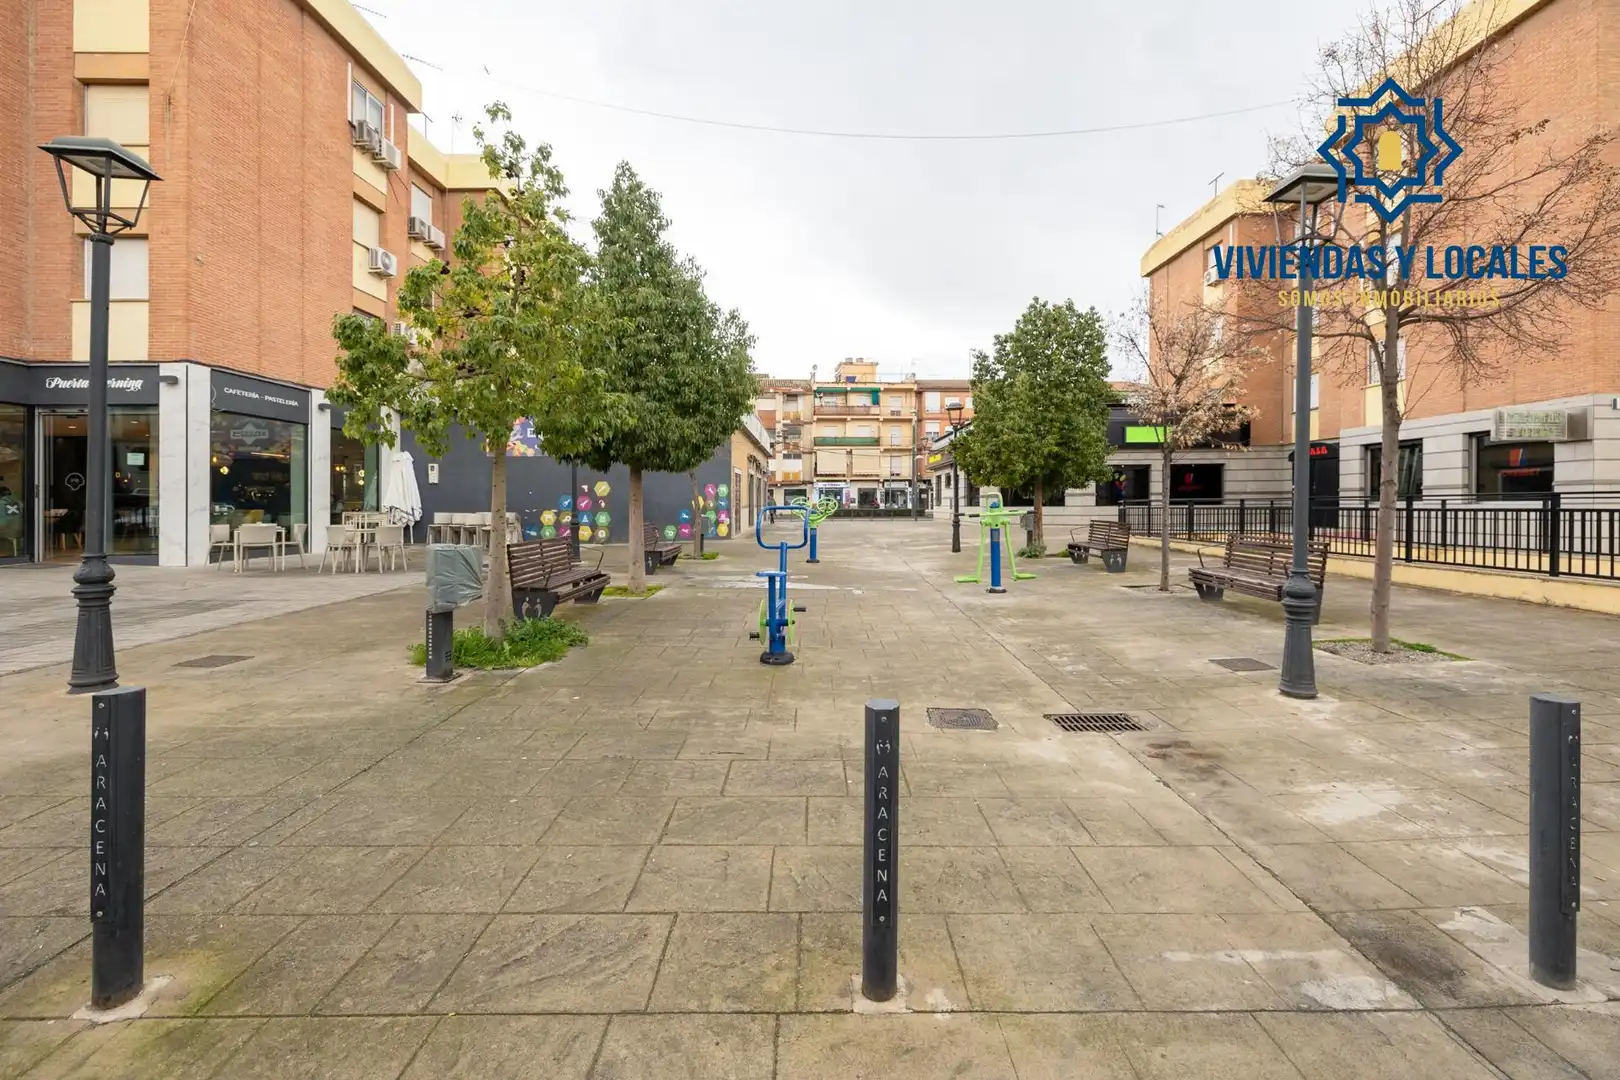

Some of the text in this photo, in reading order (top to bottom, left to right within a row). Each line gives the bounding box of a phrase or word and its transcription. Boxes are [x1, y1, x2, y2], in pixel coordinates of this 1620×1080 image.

[45, 377, 90, 389] Puerta
[224, 387, 260, 400] CAFETERÍA
[264, 395, 299, 407] PASTELERÍA
